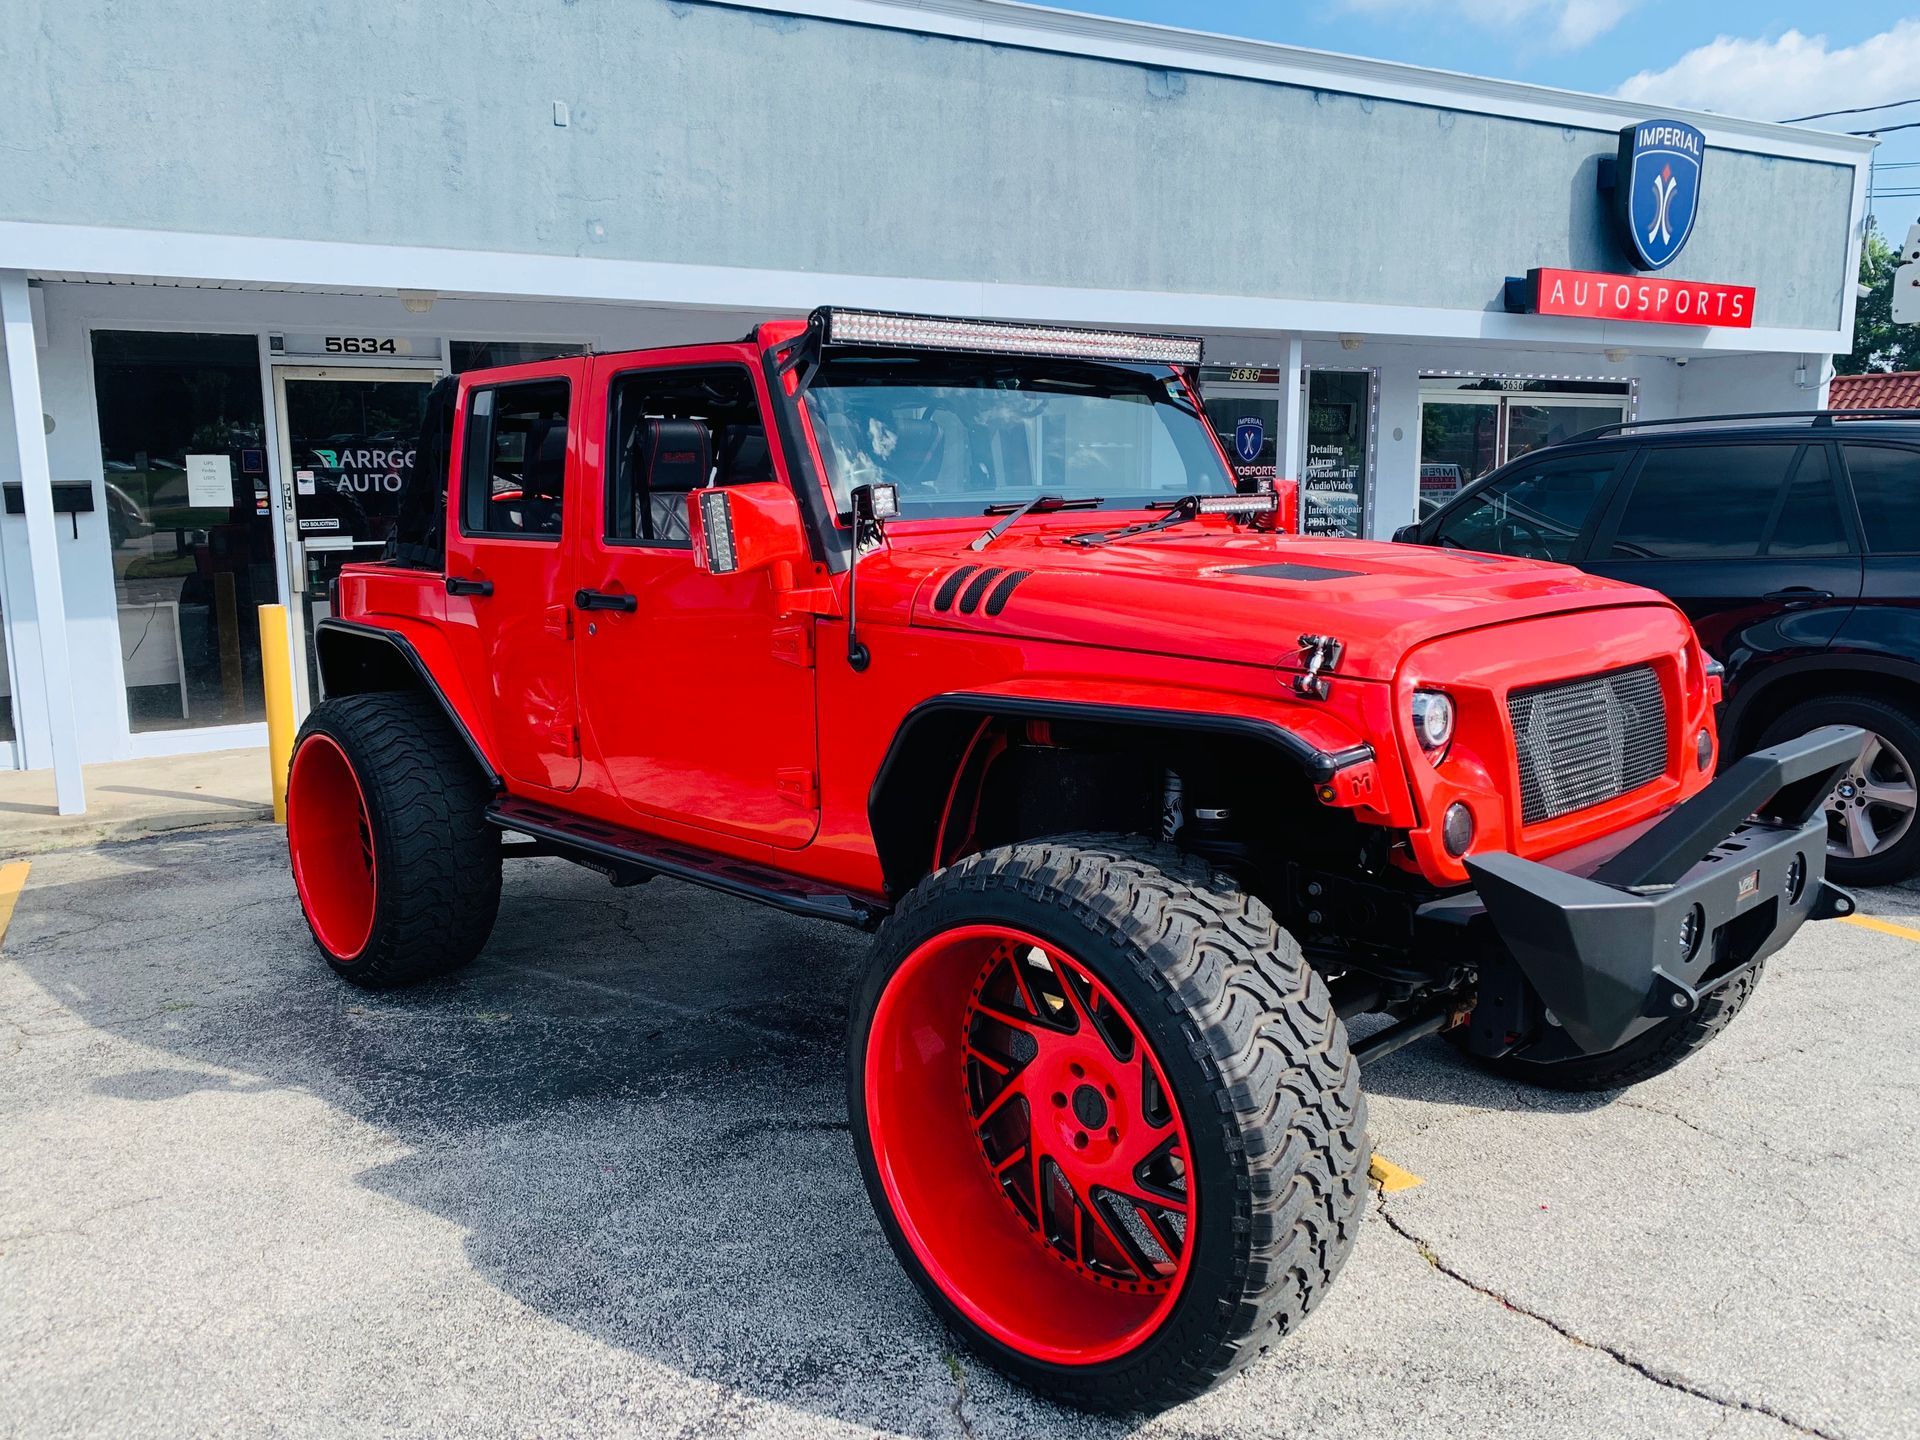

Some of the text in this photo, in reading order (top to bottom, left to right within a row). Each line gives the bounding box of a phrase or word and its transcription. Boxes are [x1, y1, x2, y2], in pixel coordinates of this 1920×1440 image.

[1638, 126, 1700, 156] IMPERIAL
[1549, 278, 1745, 318] AUTOSPORTS
[324, 336, 397, 354] 5634
[1231, 368, 1260, 380] 5636
[1503, 380, 1523, 390] 5636
[1237, 417, 1263, 427] IMPERIAL
[1310, 444, 1344, 456] Detailing
[1309, 456, 1337, 466] Alarms
[1310, 468, 1357, 478] Window Tint
[336, 473, 402, 492] AUTO
[283, 483, 293, 510] PULL
[1308, 504, 1363, 516] Interior Repair
[310, 520, 338, 528] SOLICITING
[1307, 517, 1348, 527] PDR Dents
[1326, 528, 1345, 538] Sales
